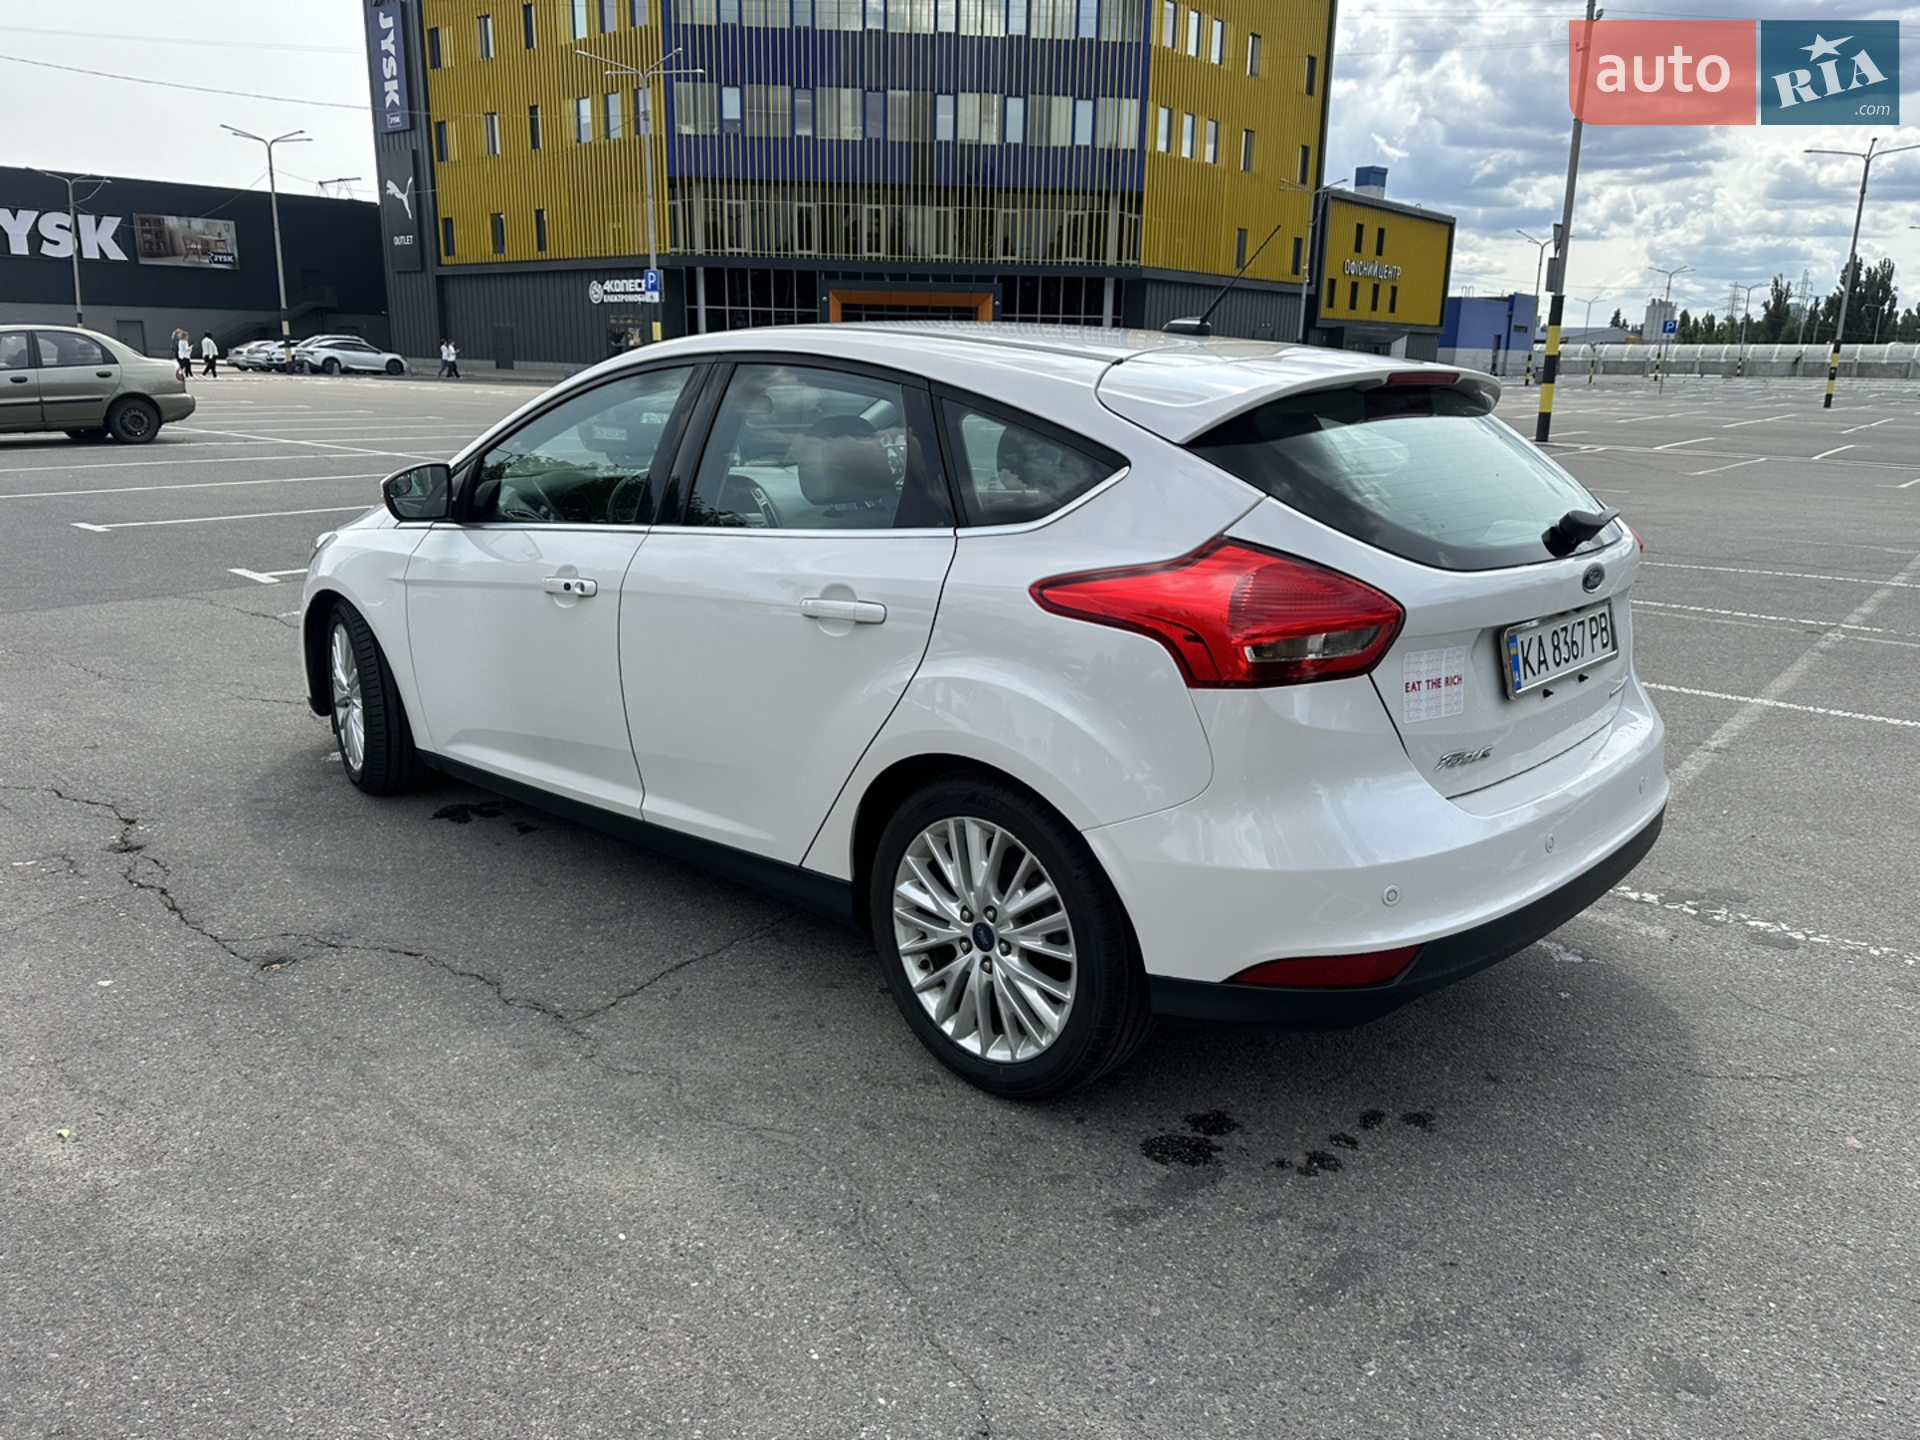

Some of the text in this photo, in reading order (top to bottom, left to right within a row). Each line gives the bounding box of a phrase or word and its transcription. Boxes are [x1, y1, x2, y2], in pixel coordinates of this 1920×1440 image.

[379, 12, 400, 109] JYSK
[393, 235, 413, 245] OUTLET
[647, 272, 657, 289] P
[1379, 264, 1402, 281] ЦЕНТР
[603, 279, 645, 292] 4КОЛЕС
[1666, 321, 1675, 332] P
[1520, 633, 1549, 680] KA
[1551, 618, 1585, 667] 8367
[1588, 611, 1610, 654] PB
[1405, 675, 1462, 693] EAT THE RICH
